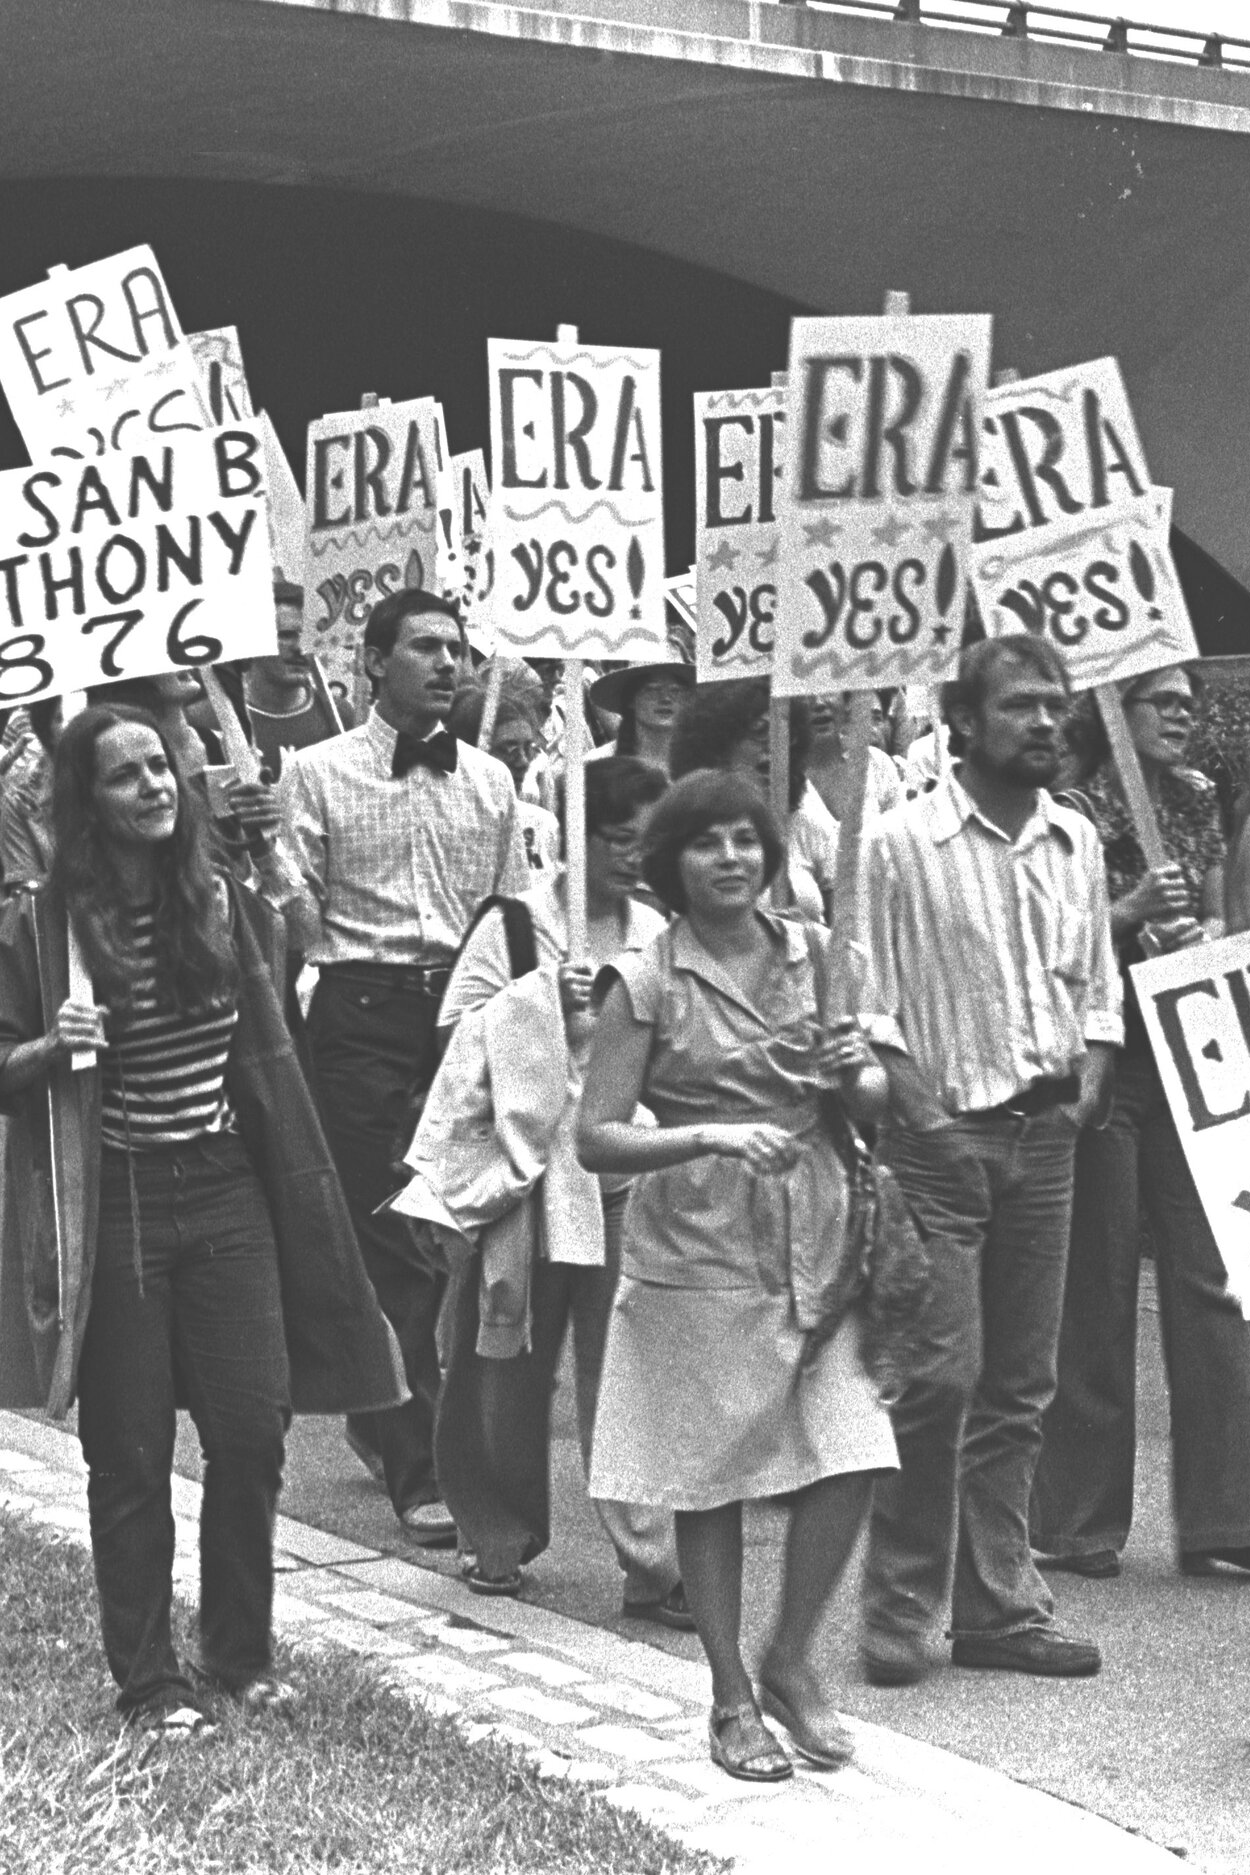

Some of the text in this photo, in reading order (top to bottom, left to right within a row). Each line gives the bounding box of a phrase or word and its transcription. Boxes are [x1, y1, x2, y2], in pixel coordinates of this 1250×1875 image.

[14, 267, 180, 395] ERA
[312, 420, 434, 531] ERA
[499, 368, 655, 492] ERA
[799, 349, 976, 501] ERA
[972, 389, 1148, 544] ERA
[18, 446, 173, 547] SAN
[0, 509, 257, 627] THONY
[511, 535, 645, 620] YES!
[802, 541, 957, 649] YES!
[997, 539, 1163, 645] YES!
